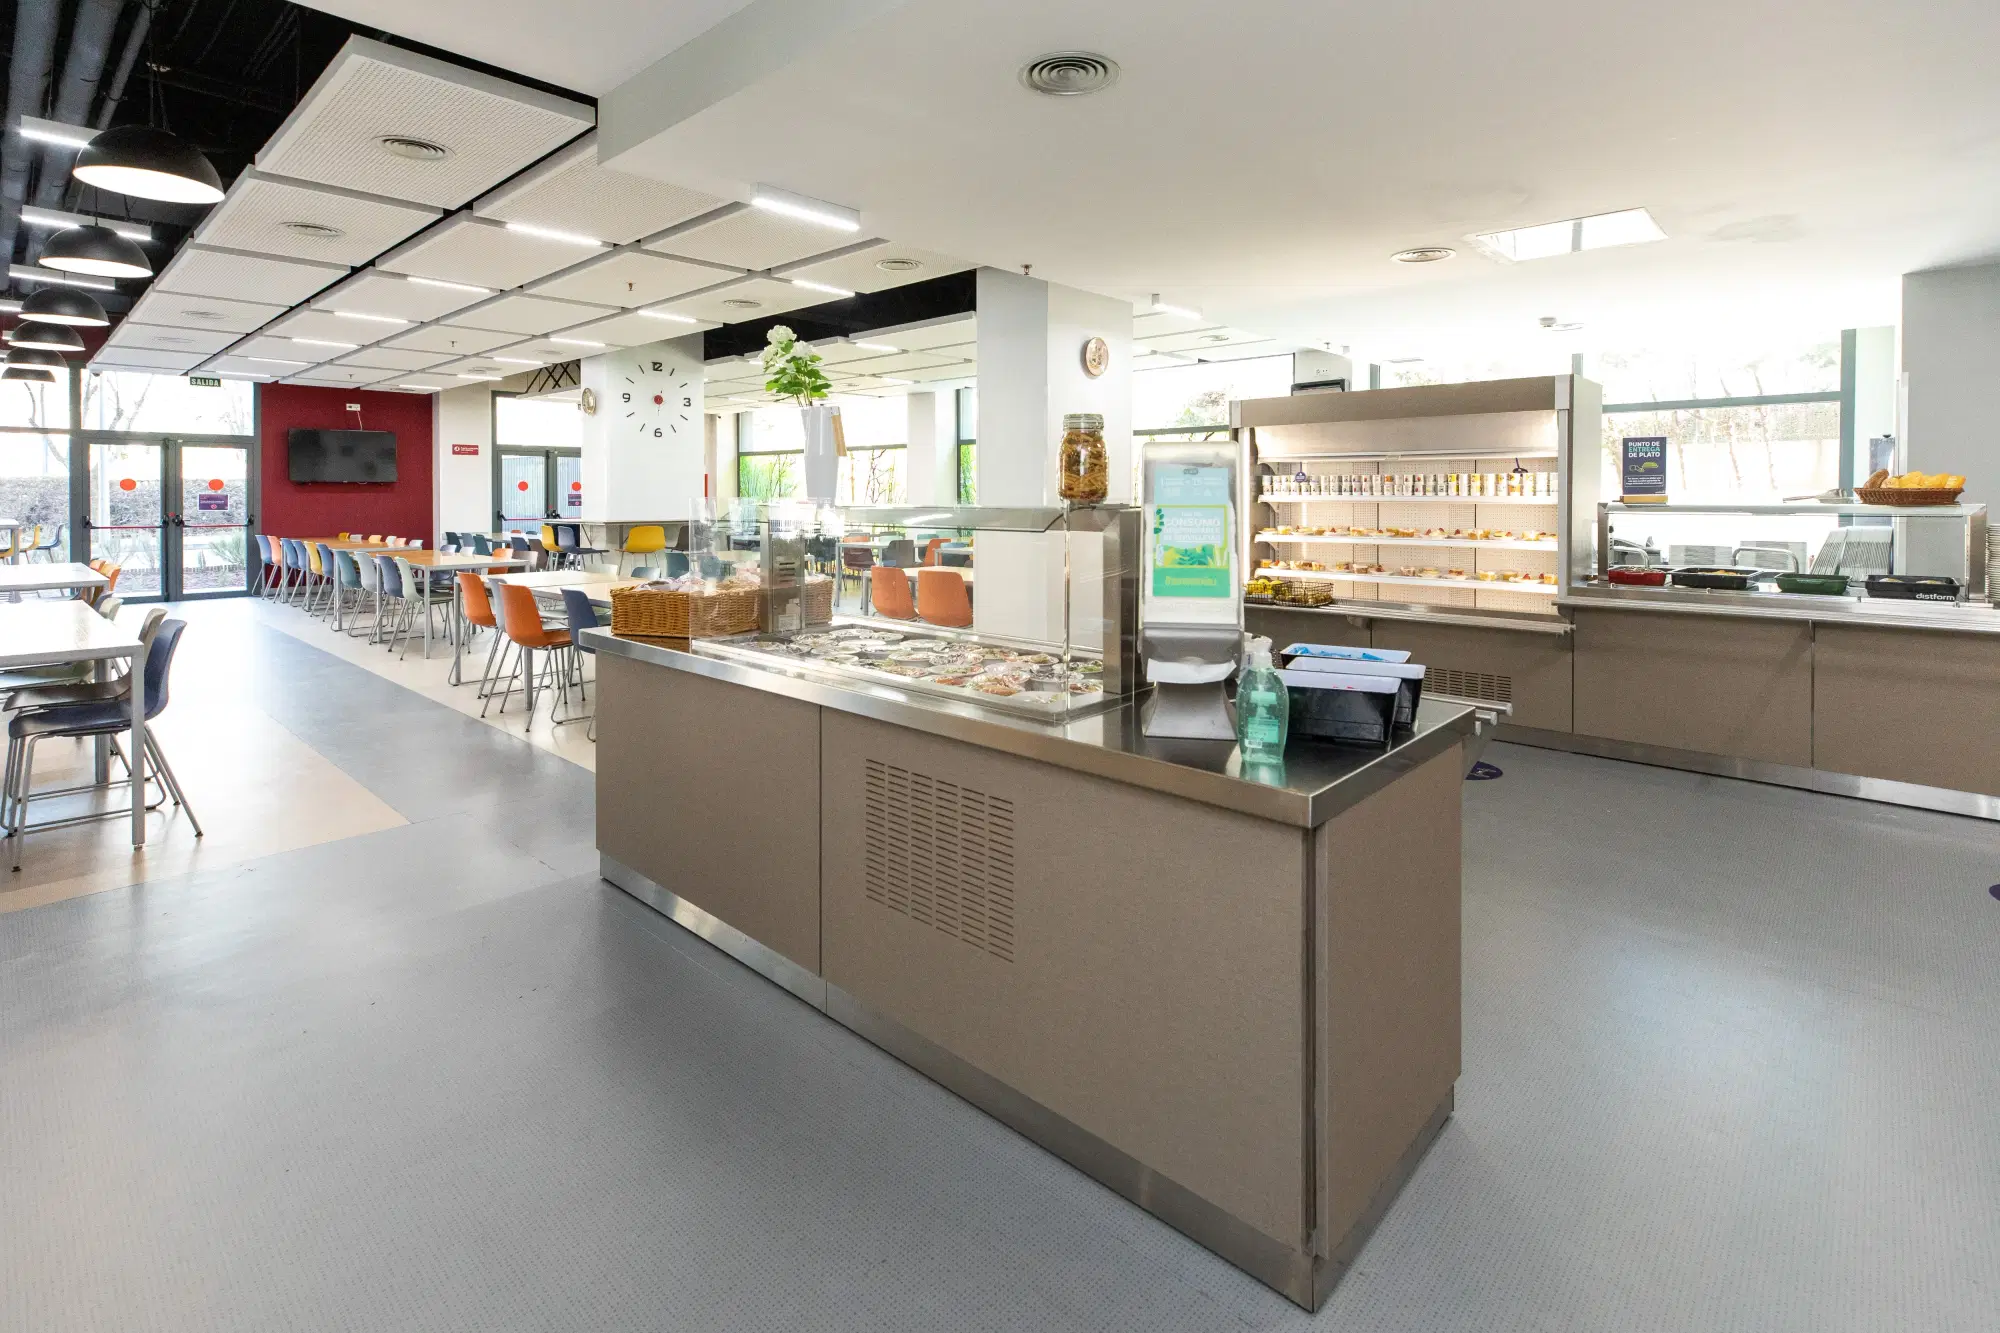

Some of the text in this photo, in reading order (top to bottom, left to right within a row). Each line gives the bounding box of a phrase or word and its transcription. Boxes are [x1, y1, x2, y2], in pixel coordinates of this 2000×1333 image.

[652, 361, 663, 372] 12
[191, 378, 219, 387] SALIDA
[622, 392, 631, 403] 9
[683, 397, 691, 407] 3
[654, 427, 663, 438] 6
[1915, 592, 1955, 601] distform
